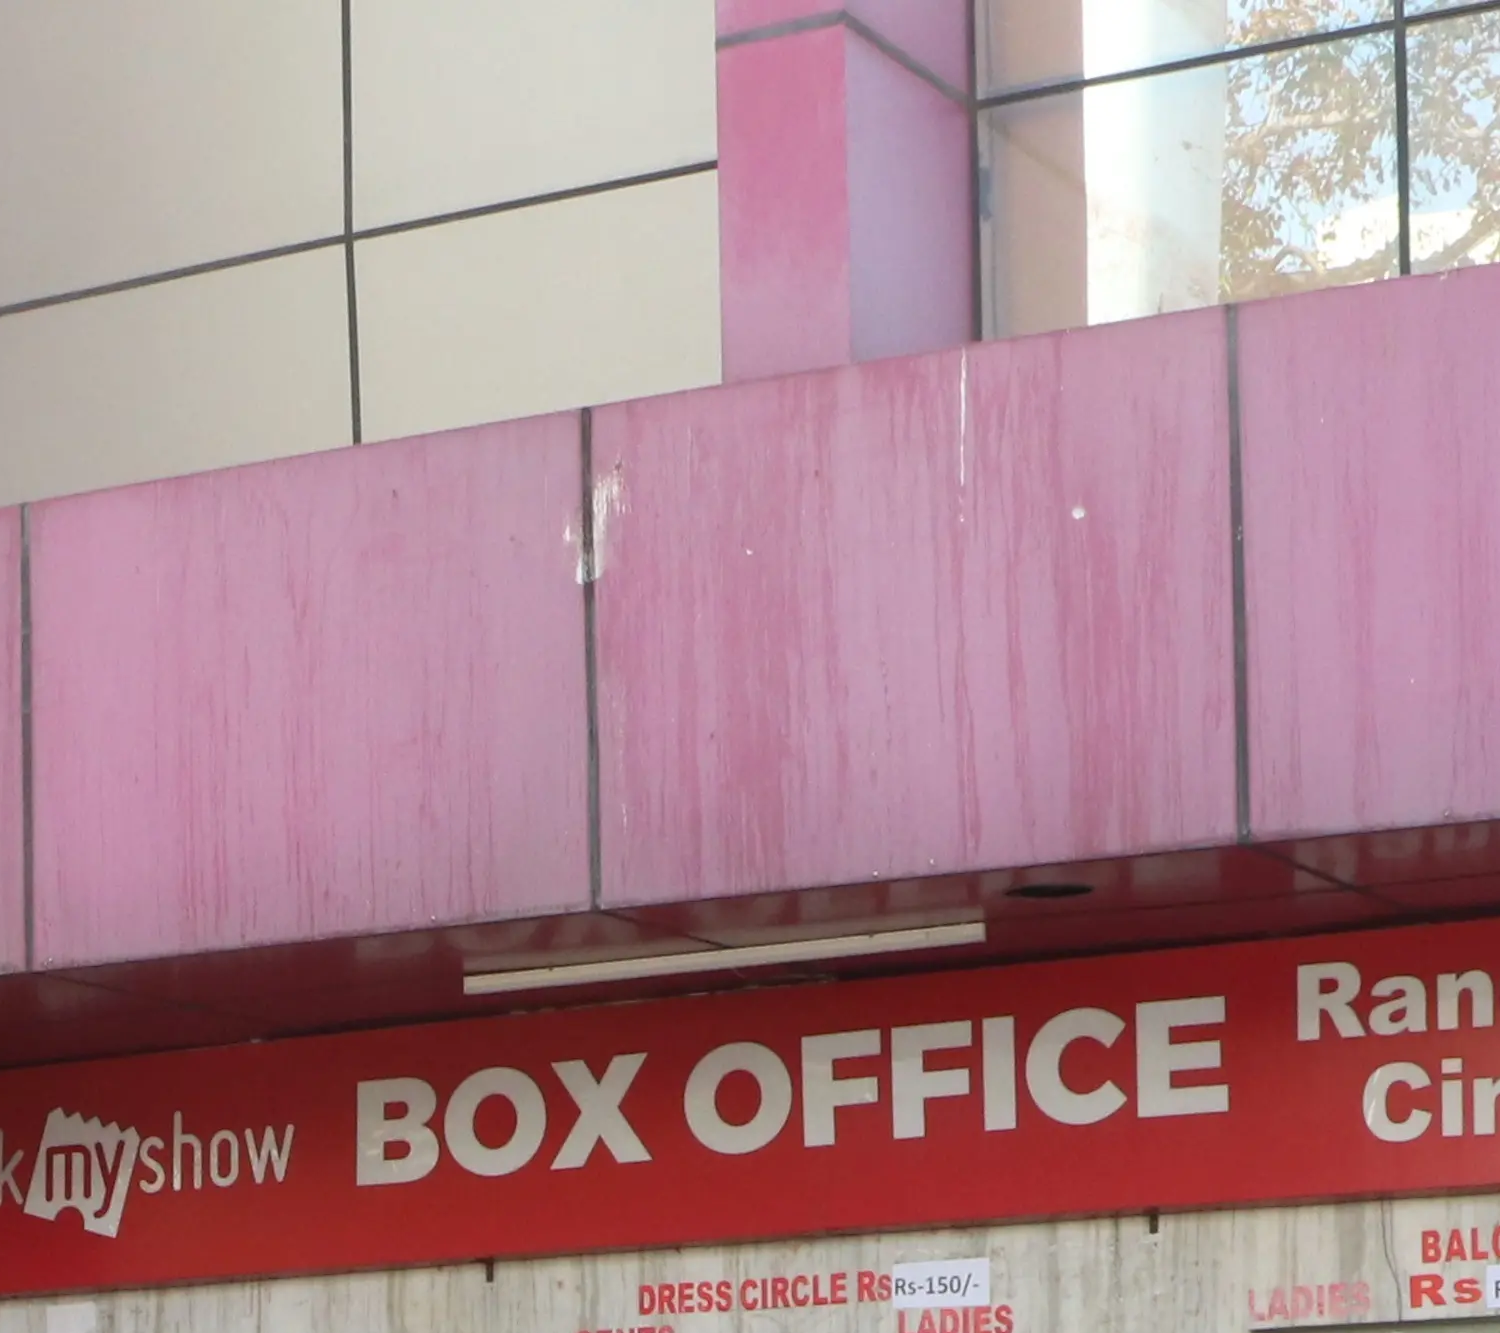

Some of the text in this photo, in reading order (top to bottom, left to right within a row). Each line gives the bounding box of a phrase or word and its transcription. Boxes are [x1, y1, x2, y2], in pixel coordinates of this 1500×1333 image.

[356, 1051, 651, 1187] BOX
[683, 994, 1231, 1156] OFFICE
[637, 1279, 733, 1316] DRESS
[739, 1272, 848, 1311] CIRCLE
[894, 1268, 979, 1298] Rs-150/-
